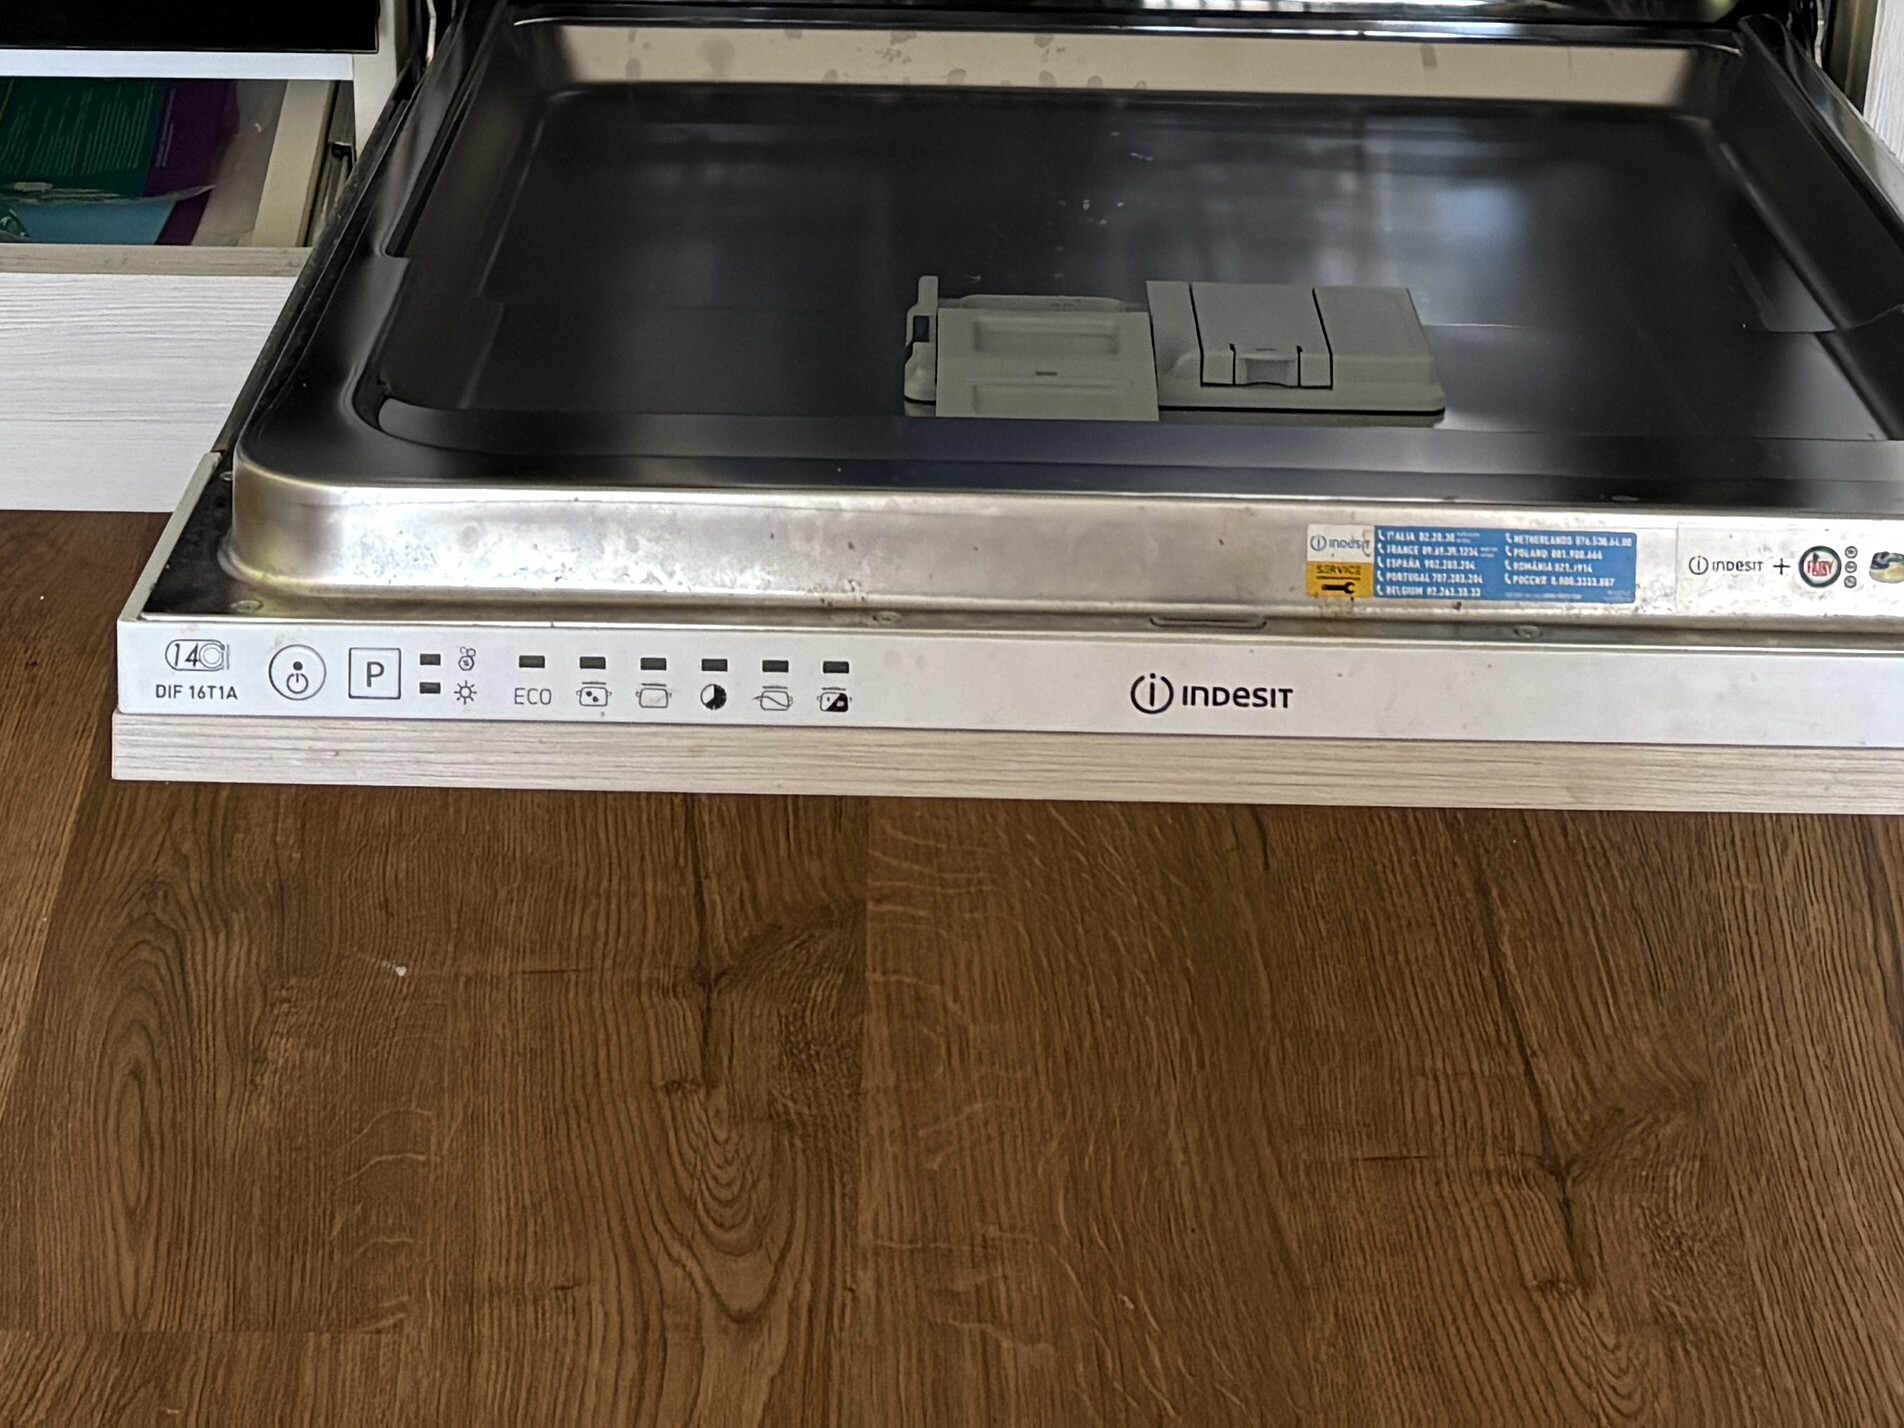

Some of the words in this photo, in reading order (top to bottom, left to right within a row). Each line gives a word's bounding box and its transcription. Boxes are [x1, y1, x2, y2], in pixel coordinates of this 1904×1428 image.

[1386, 544, 1419, 555] FRANCE
[1513, 548, 1549, 559] POLAND
[1385, 571, 1430, 583] PORTUGAL
[366, 661, 385, 688] P
[155, 684, 183, 699] DIF
[189, 685, 239, 701] 16T1A
[513, 687, 552, 706] ECO
[1181, 684, 1294, 709] INDESIT
